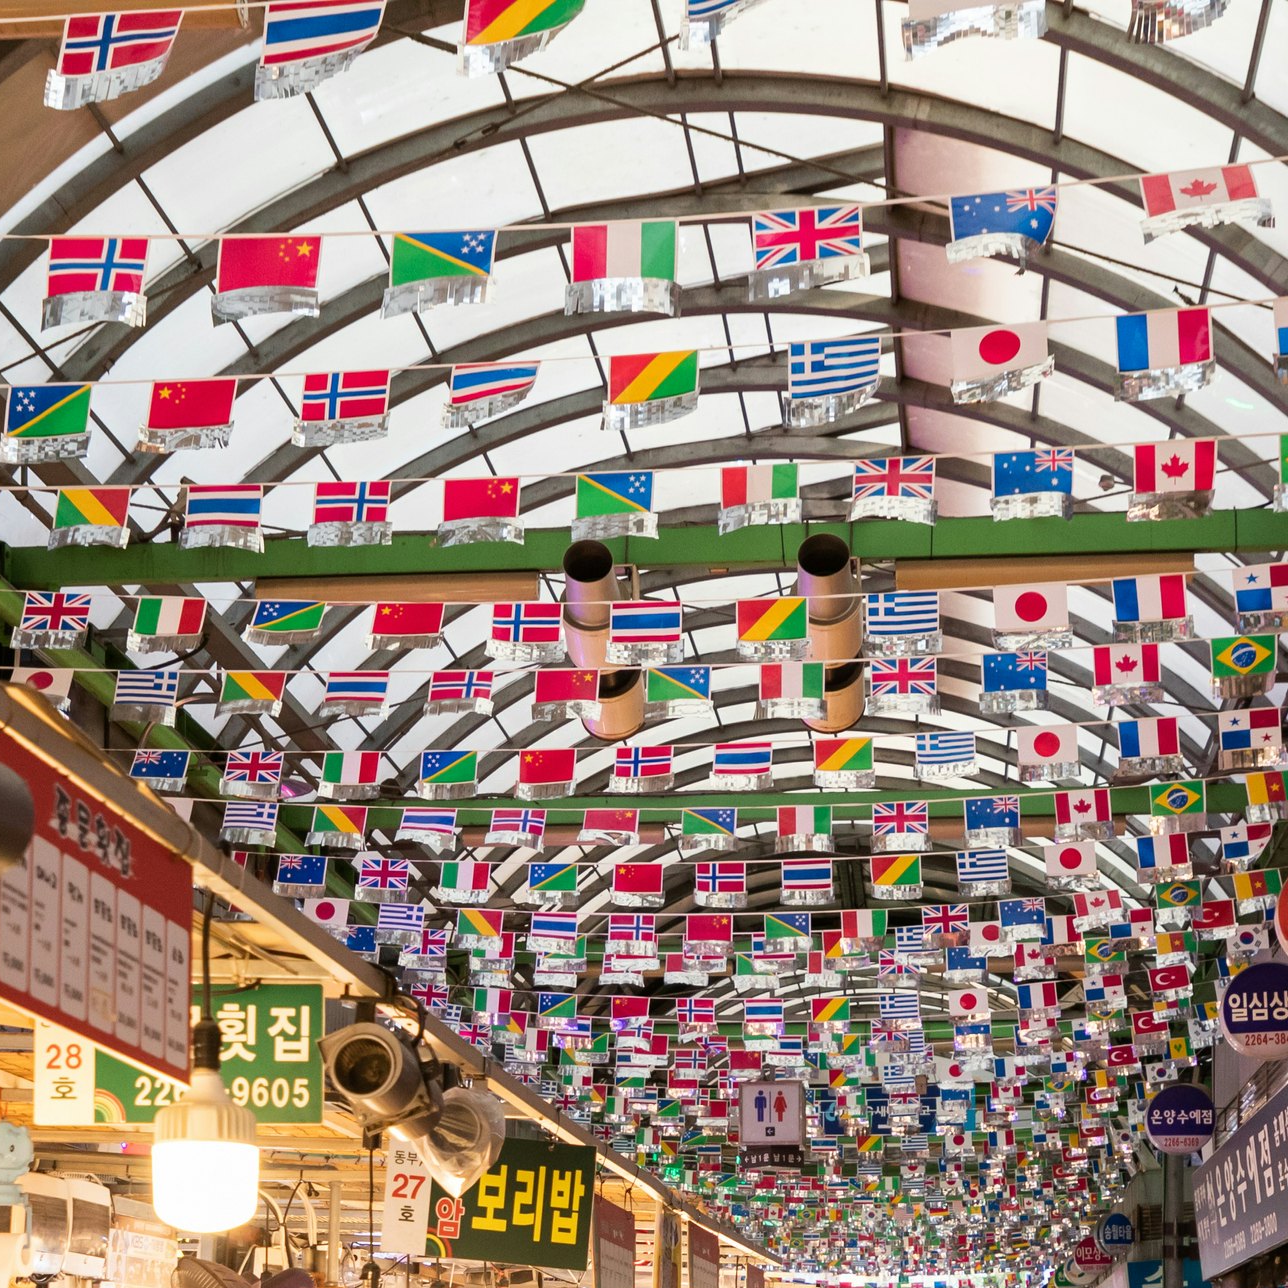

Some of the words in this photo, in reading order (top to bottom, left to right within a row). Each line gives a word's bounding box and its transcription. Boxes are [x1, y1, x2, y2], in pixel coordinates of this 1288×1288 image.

[190, 1003, 311, 1063] 횟집
[45, 1044, 83, 1070] 28
[50, 1077, 78, 1100] 호
[1150, 1109, 1213, 1125] 온양수예점
[392, 1173, 426, 1200] 27
[1215, 1123, 1276, 1228] 온양수예점
[398, 1205, 415, 1223] 호
[436, 1197, 465, 1240] 암
[471, 1164, 586, 1246] 보리밥
